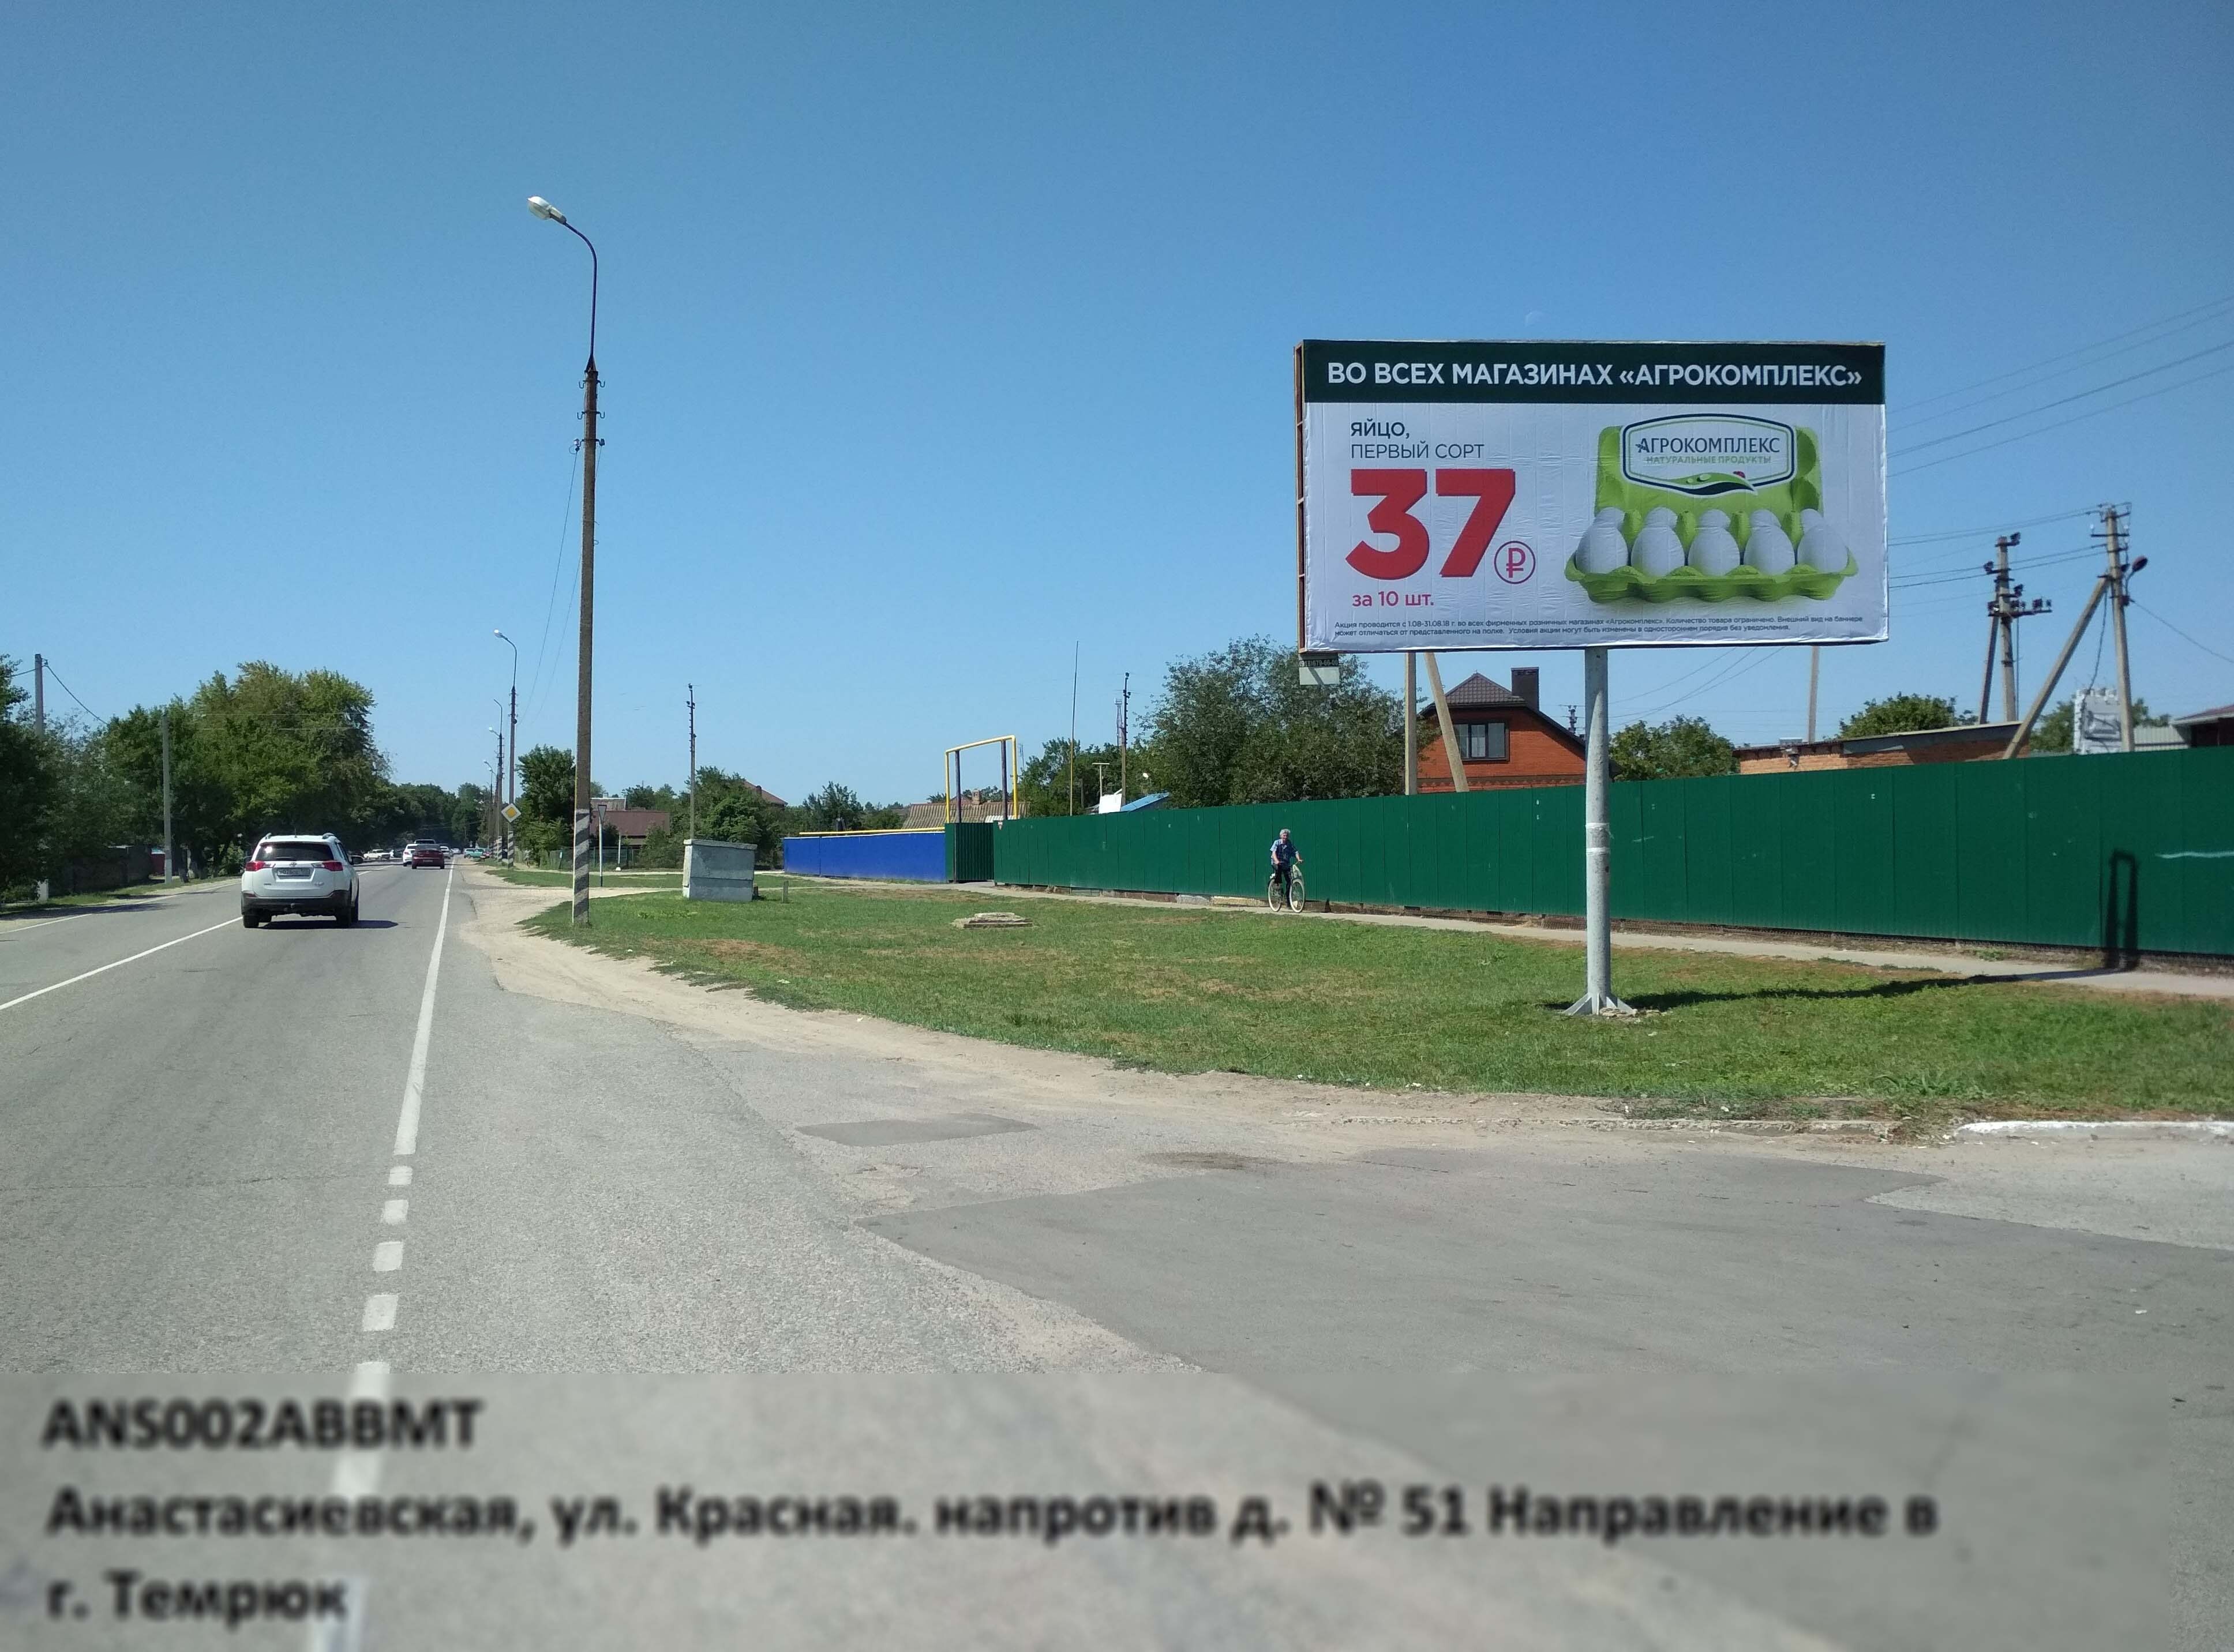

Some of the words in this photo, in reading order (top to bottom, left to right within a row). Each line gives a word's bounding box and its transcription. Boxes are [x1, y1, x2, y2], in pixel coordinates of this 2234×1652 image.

[1328, 362, 1366, 384] ВО
[1374, 362, 1445, 385] ВСЕХ
[1452, 363, 1614, 386] МАГАЗИНАХ
[1619, 364, 1862, 386] «АГРОКОМПЛЕКС»
[1351, 418, 1410, 440] ЯЙЦО,
[1351, 440, 1429, 459] ПЕРВЫЙ
[1435, 444, 1485, 459] СОРТ
[1635, 437, 1781, 453] АГРОКОМПЛЕКС
[1646, 456, 1716, 464] НАТУРАЛЬНЫЕ
[1719, 456, 1771, 464] ПРОДУКТЫ
[1345, 468, 1516, 580] 37
[1352, 594, 1372, 606] за
[1378, 591, 1399, 606] 10
[1405, 594, 1434, 606] шт.
